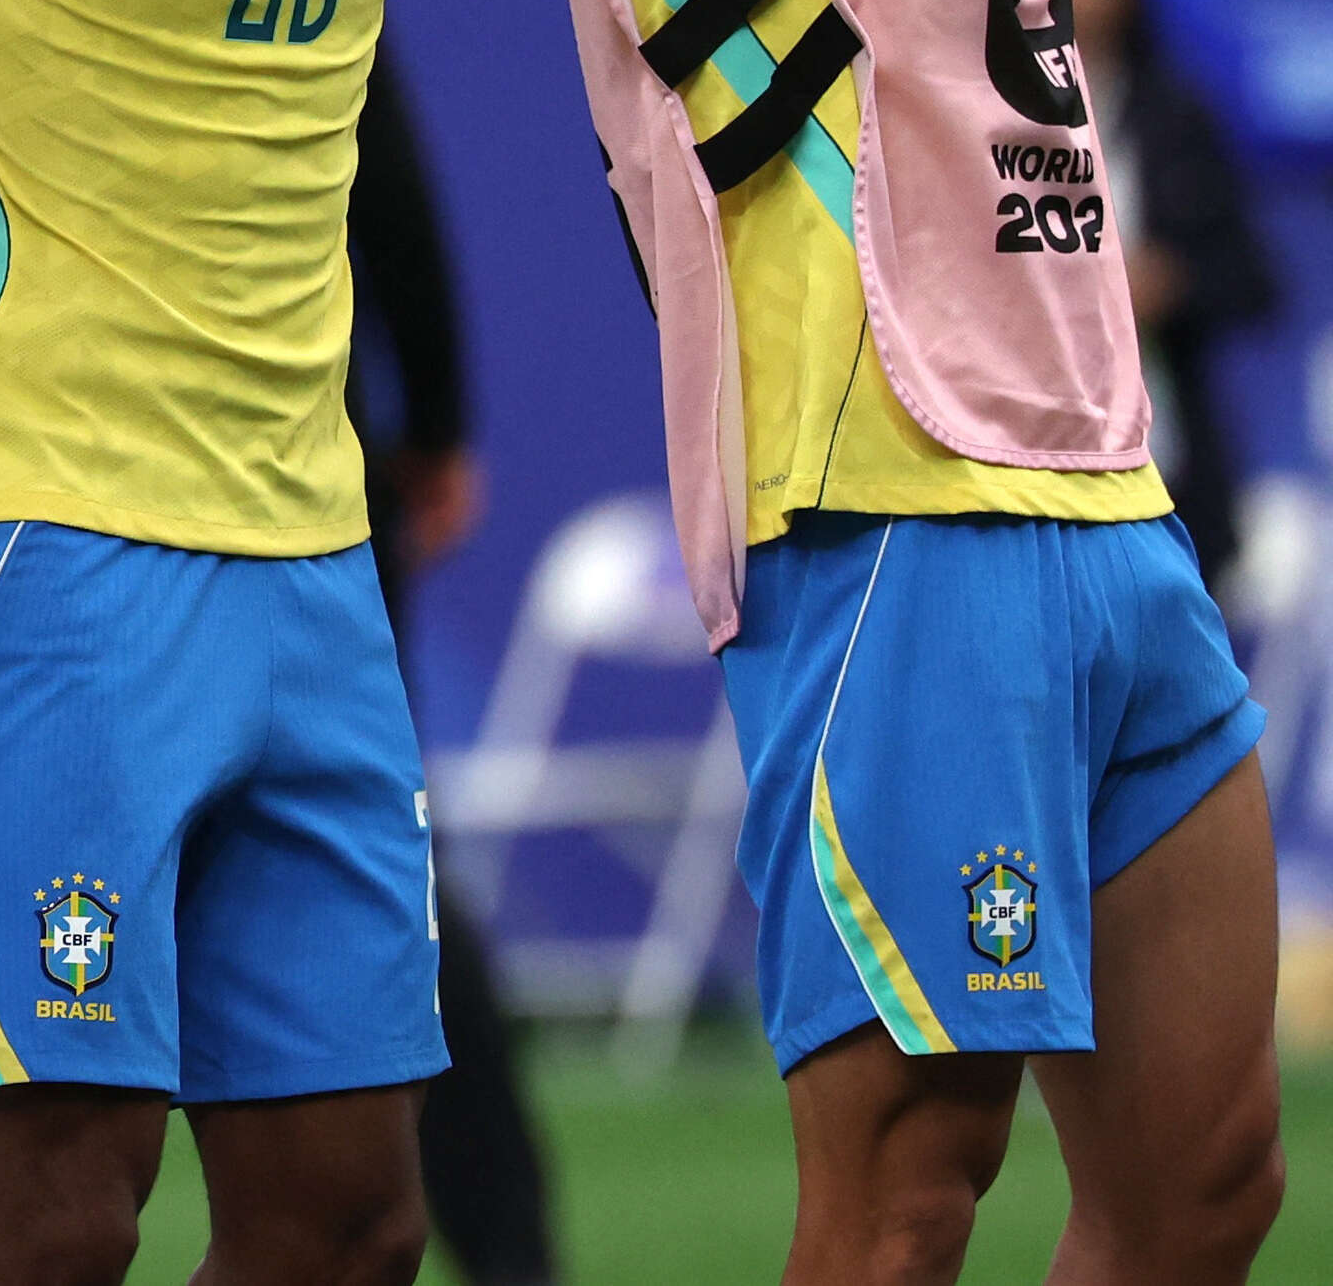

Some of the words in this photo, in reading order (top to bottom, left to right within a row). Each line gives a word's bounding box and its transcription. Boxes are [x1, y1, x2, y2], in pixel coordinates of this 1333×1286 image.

[991, 144, 1095, 184] WORLD
[995, 193, 1104, 254] 202
[989, 906, 1017, 919] CBF
[62, 933, 93, 946] CBF
[967, 972, 1045, 991] BRASIL
[36, 1000, 116, 1022] BRASIL
